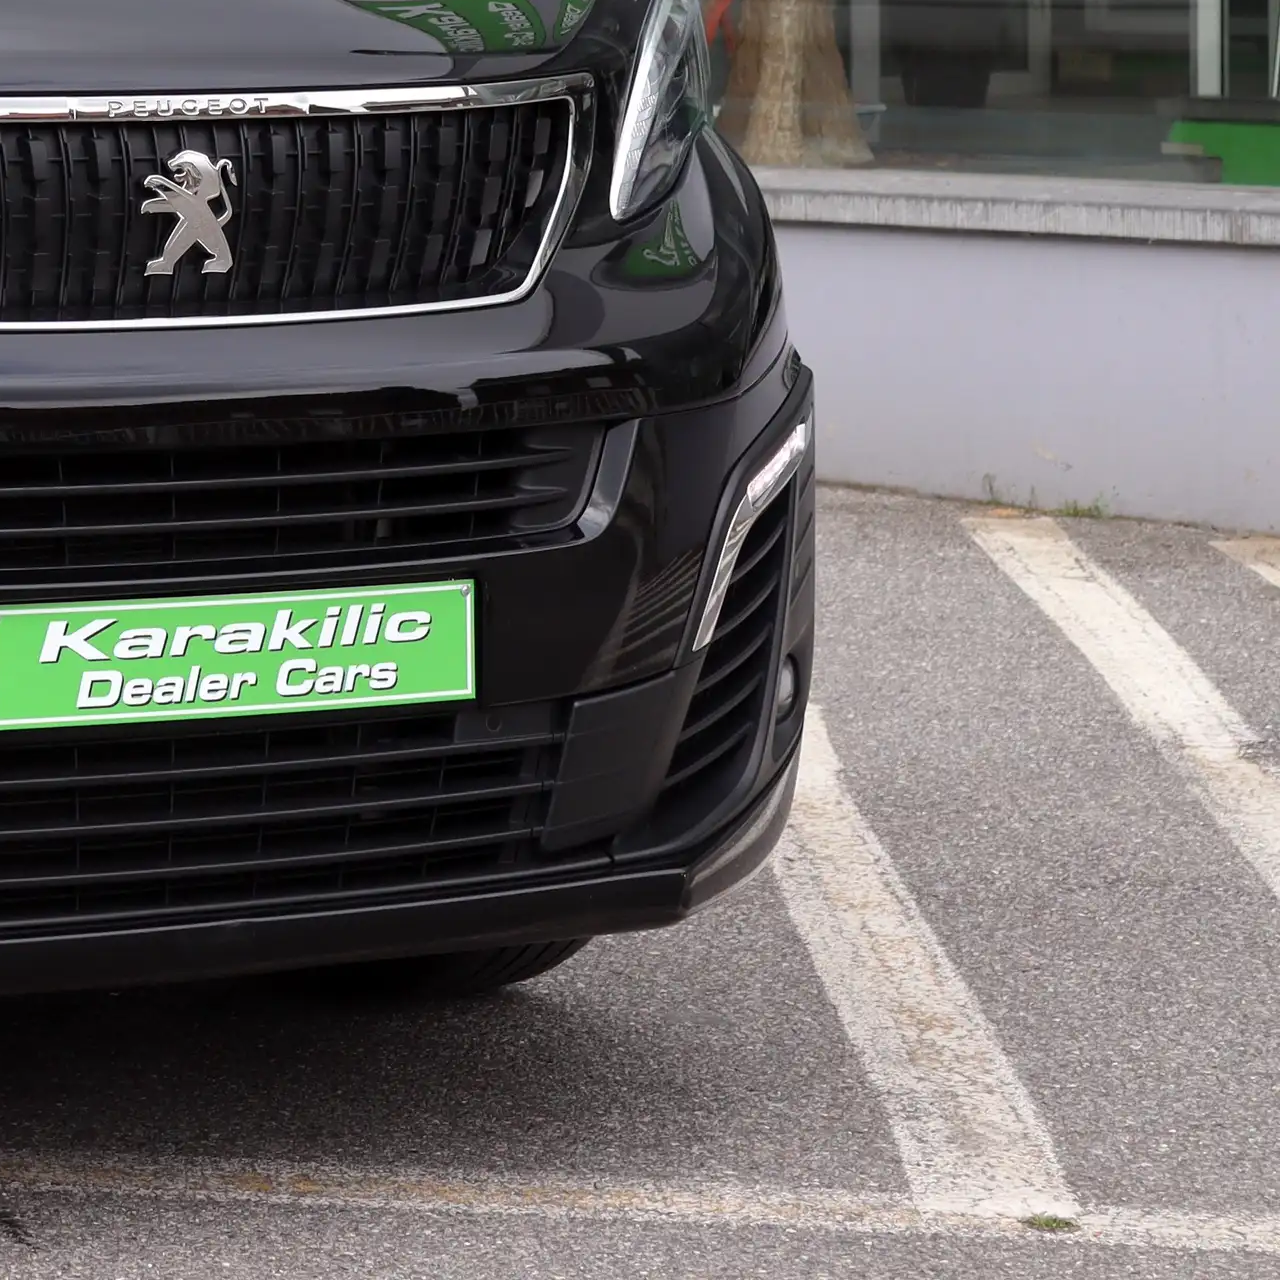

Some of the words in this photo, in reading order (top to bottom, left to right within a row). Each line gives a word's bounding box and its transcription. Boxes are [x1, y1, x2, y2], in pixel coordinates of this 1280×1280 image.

[107, 97, 269, 118] PEUGEOT
[38, 603, 431, 664] Karakilic
[76, 664, 258, 710] Dealer
[274, 657, 398, 699] Cars
